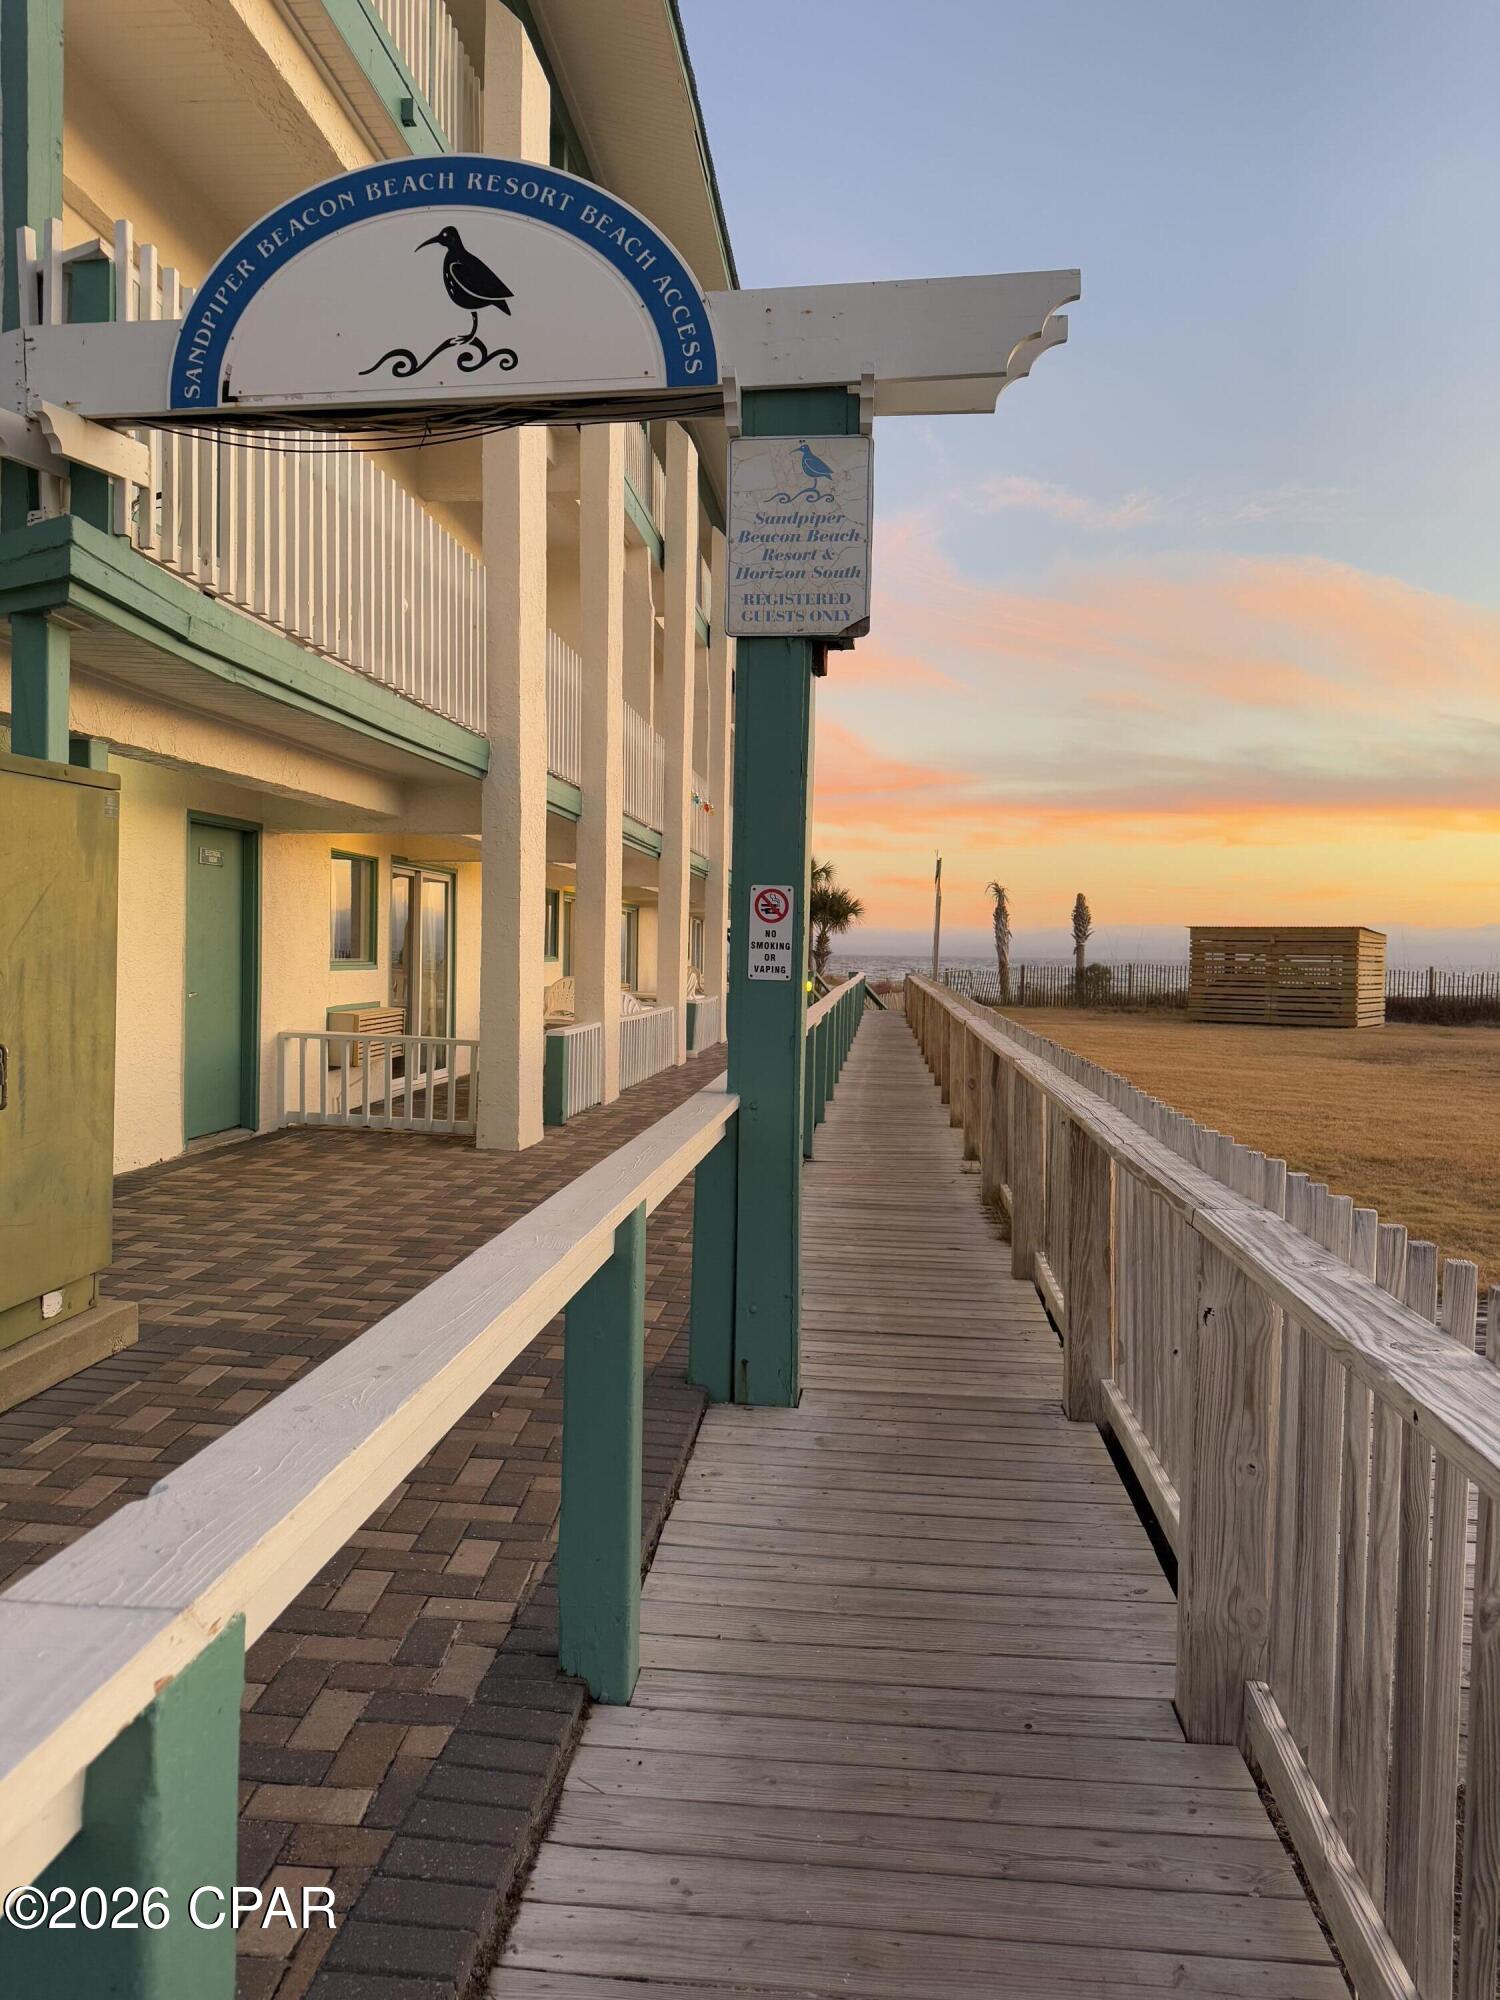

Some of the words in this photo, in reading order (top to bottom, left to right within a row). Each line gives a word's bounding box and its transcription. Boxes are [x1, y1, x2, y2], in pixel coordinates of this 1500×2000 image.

[184, 259, 255, 399] SANDPIPER
[256, 191, 355, 259] BEACON
[365, 172, 454, 201] BEACH
[467, 173, 574, 211] RESORT
[579, 205, 656, 271] BEACH
[652, 275, 702, 375] ACCESS
[753, 512, 845, 528] Sandpiper
[738, 530, 800, 544] Beacon
[807, 529, 860, 543] Beach
[762, 548, 817, 561] Resort
[822, 548, 834, 561] &
[735, 566, 806, 580] Horizon
[811, 566, 861, 579] South
[743, 593, 850, 605] REGISTERED
[741, 610, 805, 623] GUESTS
[809, 610, 852, 622] ONLY
[751, 942, 790, 950] SMOKING
[764, 953, 776, 962] OR
[754, 965, 786, 974] VAPING
